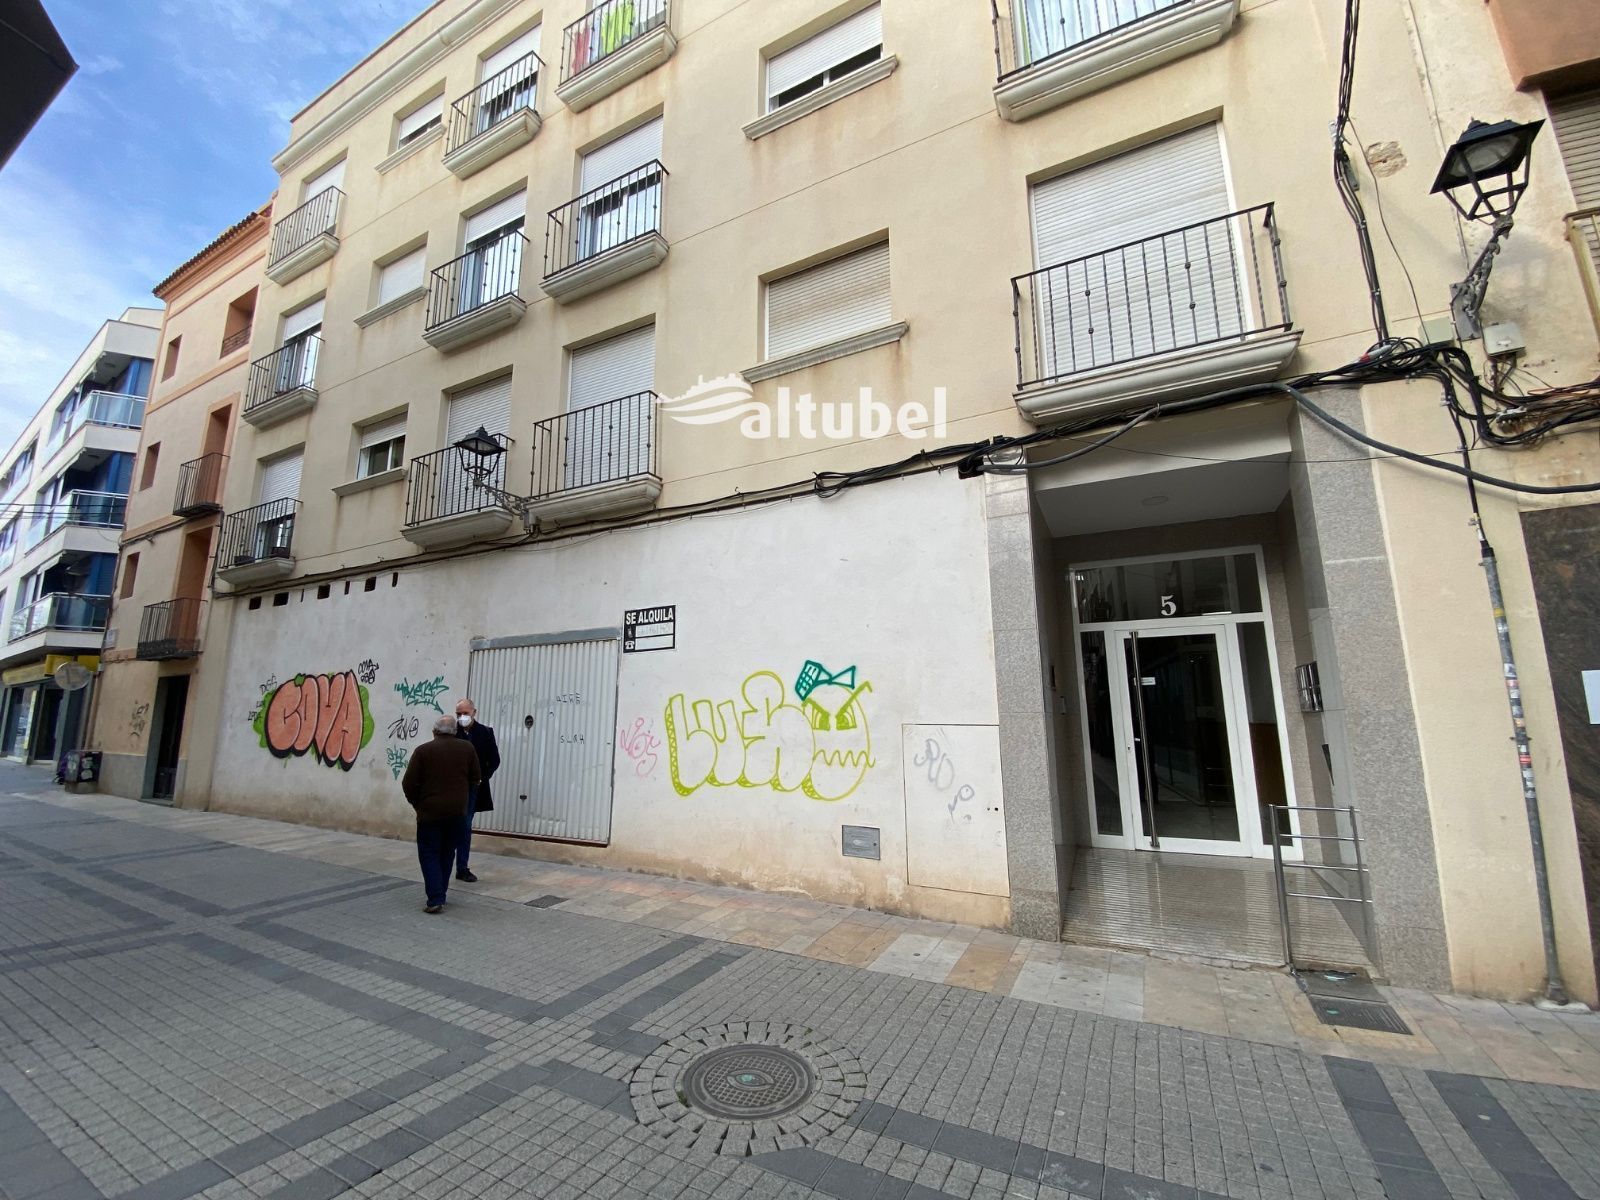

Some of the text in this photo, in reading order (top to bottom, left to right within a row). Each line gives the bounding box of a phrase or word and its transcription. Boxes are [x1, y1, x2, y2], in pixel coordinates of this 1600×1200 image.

[1161, 595, 1177, 616] 5
[626, 608, 674, 625] SE ALQUILA
